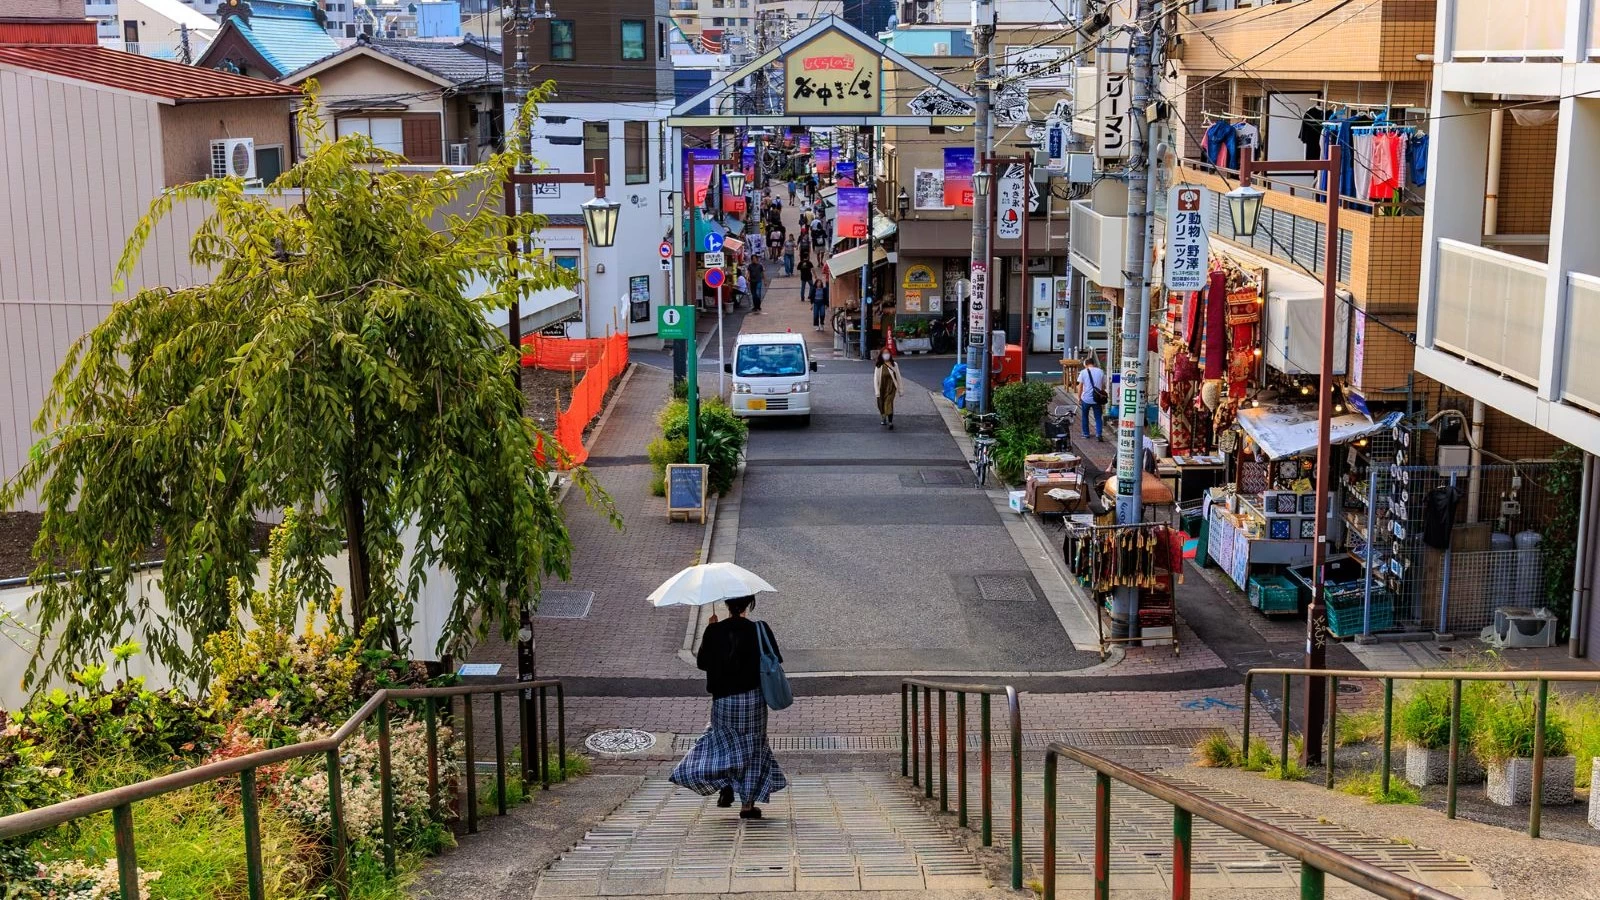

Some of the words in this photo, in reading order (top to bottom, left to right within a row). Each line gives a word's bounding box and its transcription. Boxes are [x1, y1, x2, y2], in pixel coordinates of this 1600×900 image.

[793, 67, 873, 106] 谷中ぎんざ
[1011, 183, 1020, 207] かき氷
[1174, 212, 1187, 269] クリニック
[1186, 212, 1201, 270] 動物・野澤
